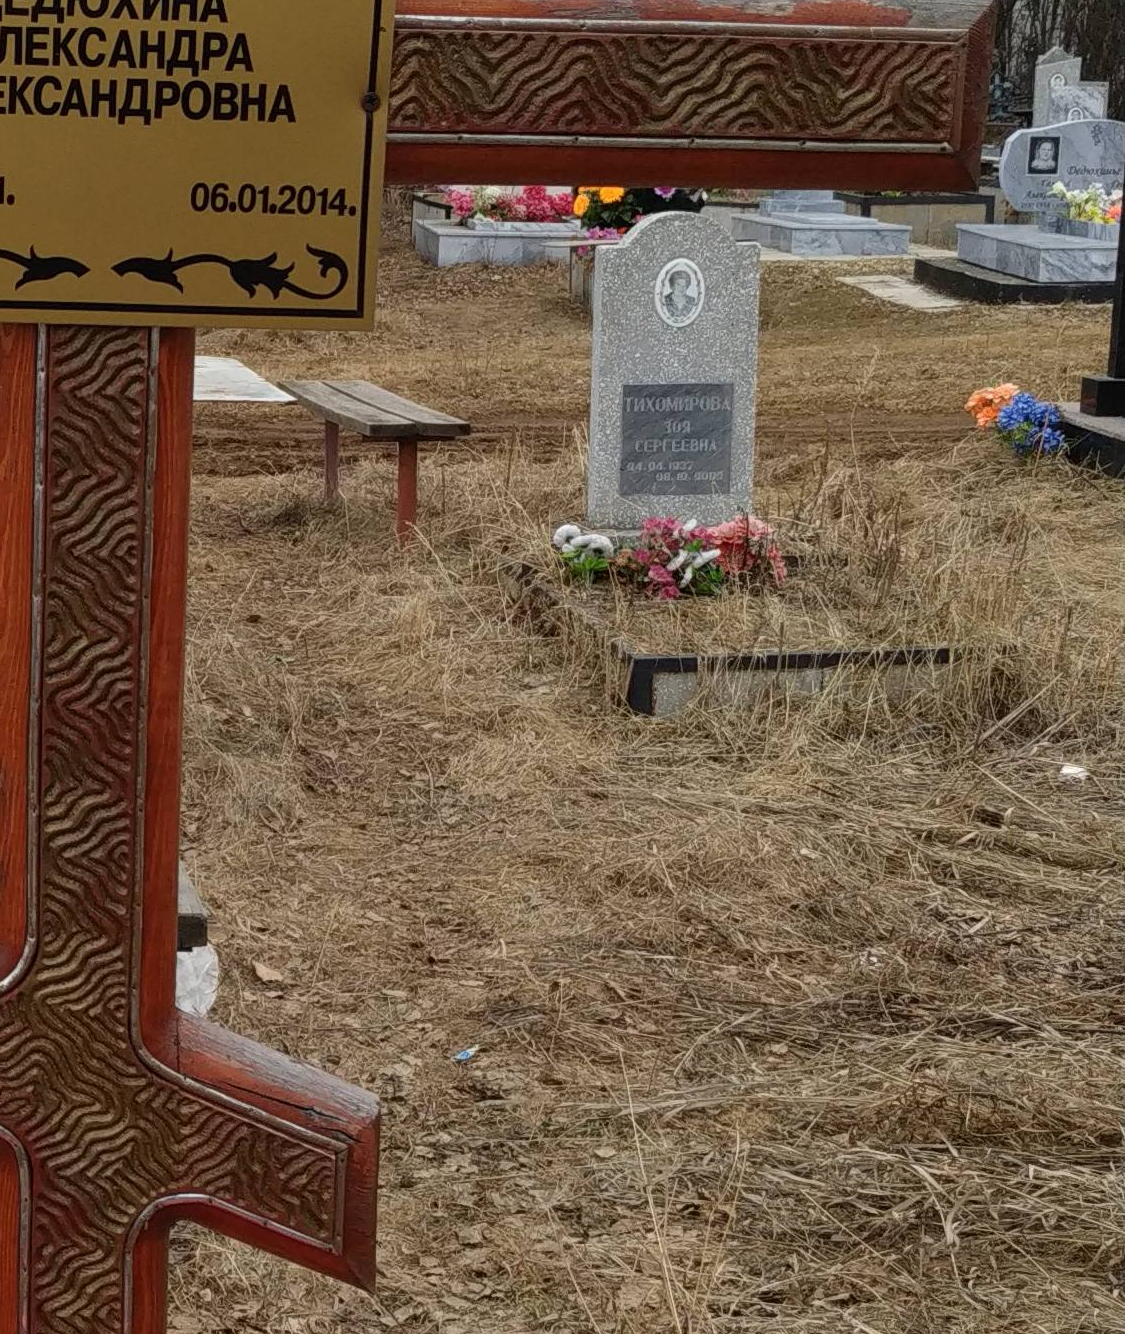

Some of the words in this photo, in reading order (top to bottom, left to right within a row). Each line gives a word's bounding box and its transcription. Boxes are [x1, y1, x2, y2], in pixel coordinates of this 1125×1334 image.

[190, 181, 357, 217] 06.01.2014.
[624, 396, 732, 412] ТИХОМИРОВА
[665, 419, 691, 434] ЗОЯ
[635, 438, 717, 453] СЕРГЕЕВНА
